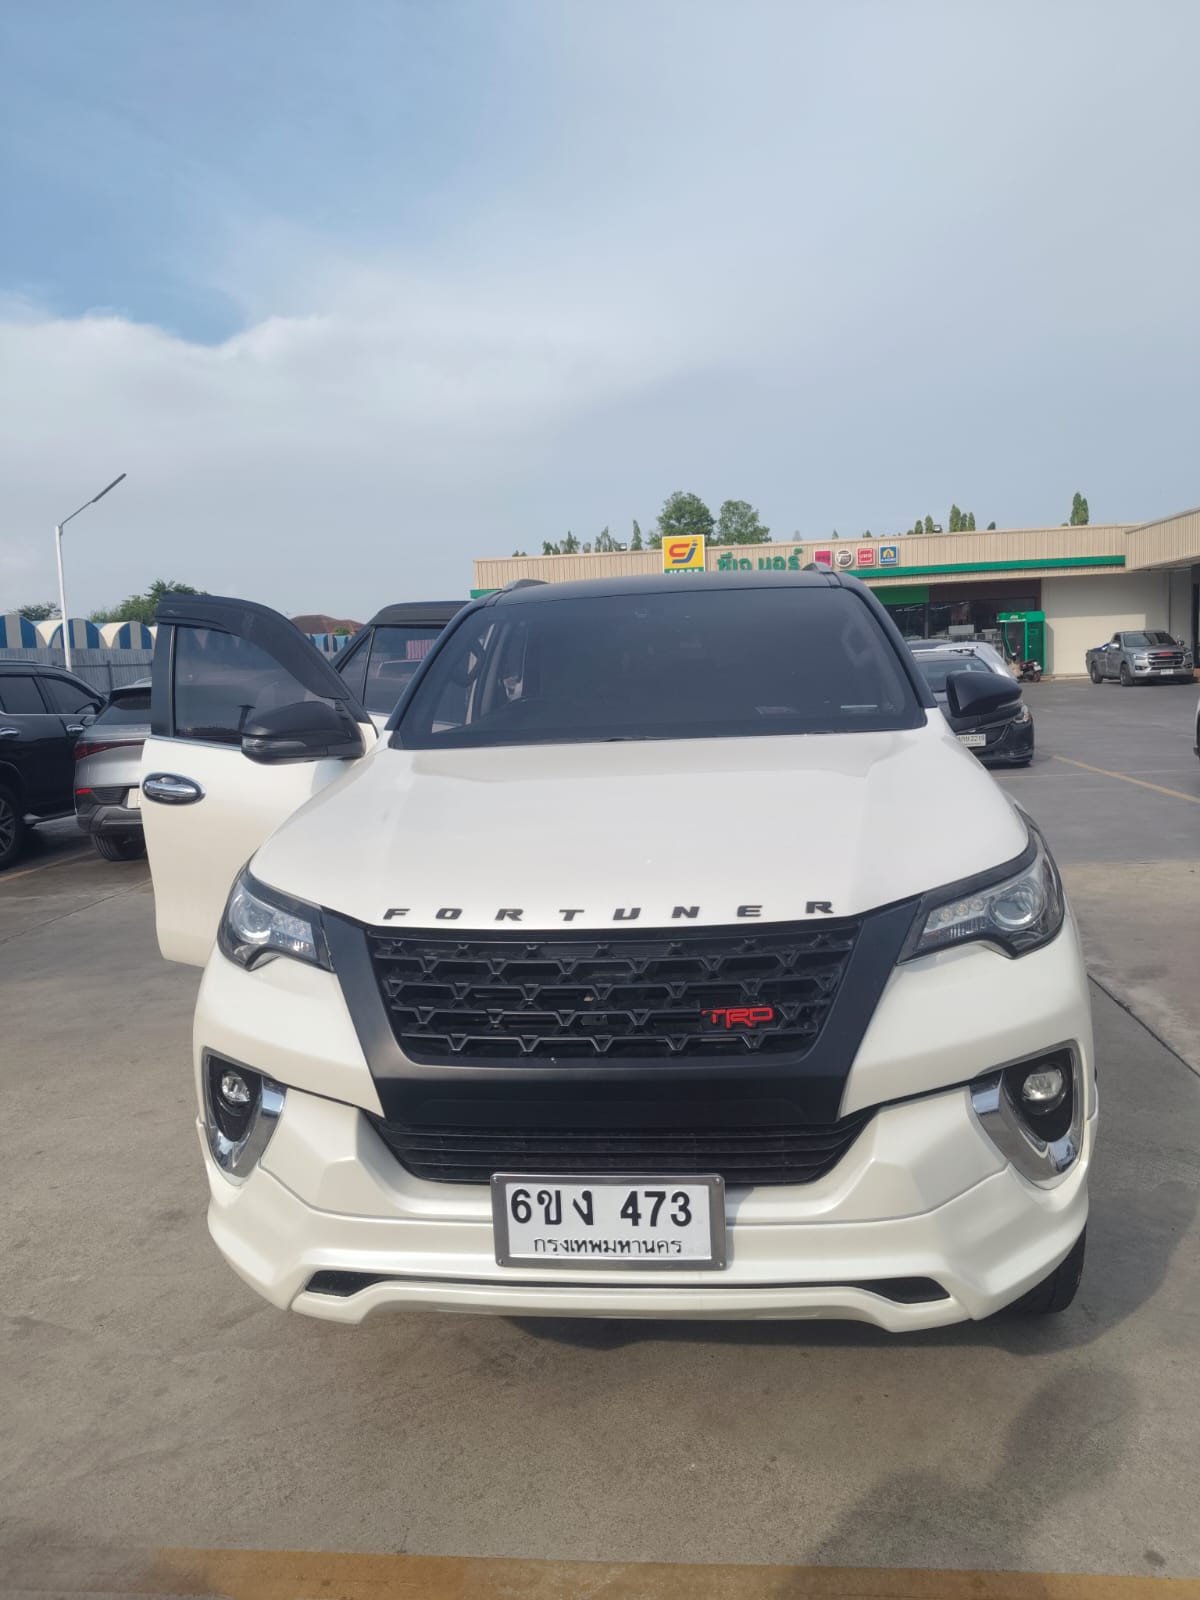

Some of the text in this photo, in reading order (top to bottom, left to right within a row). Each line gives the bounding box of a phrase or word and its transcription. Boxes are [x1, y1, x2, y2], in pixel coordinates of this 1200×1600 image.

[382, 900, 835, 922] FORTUNER
[701, 1007, 774, 1029] TRD
[620, 1190, 693, 1227] 473
